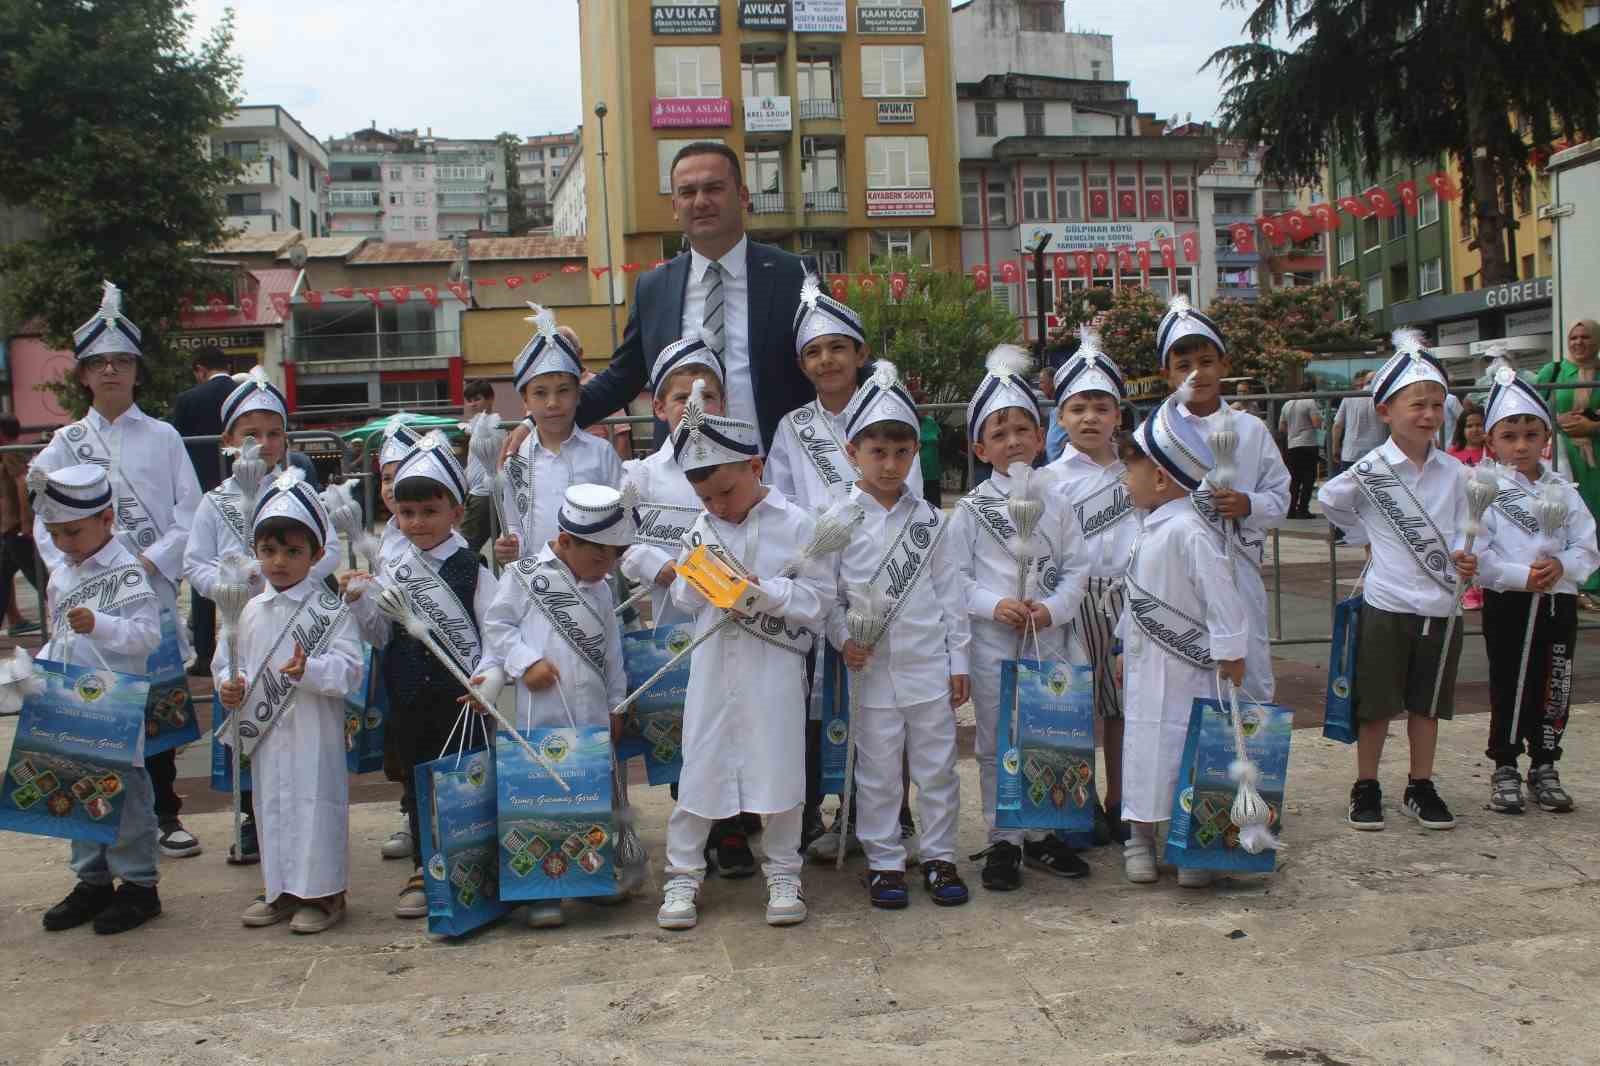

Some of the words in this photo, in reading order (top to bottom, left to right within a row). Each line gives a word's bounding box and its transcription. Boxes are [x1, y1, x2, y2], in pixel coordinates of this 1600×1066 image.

[655, 7, 716, 19] AVUKAT
[744, 3, 786, 15] AVUKAT
[861, 9, 887, 18] KAAN
[879, 103, 913, 113] AVUKAT
